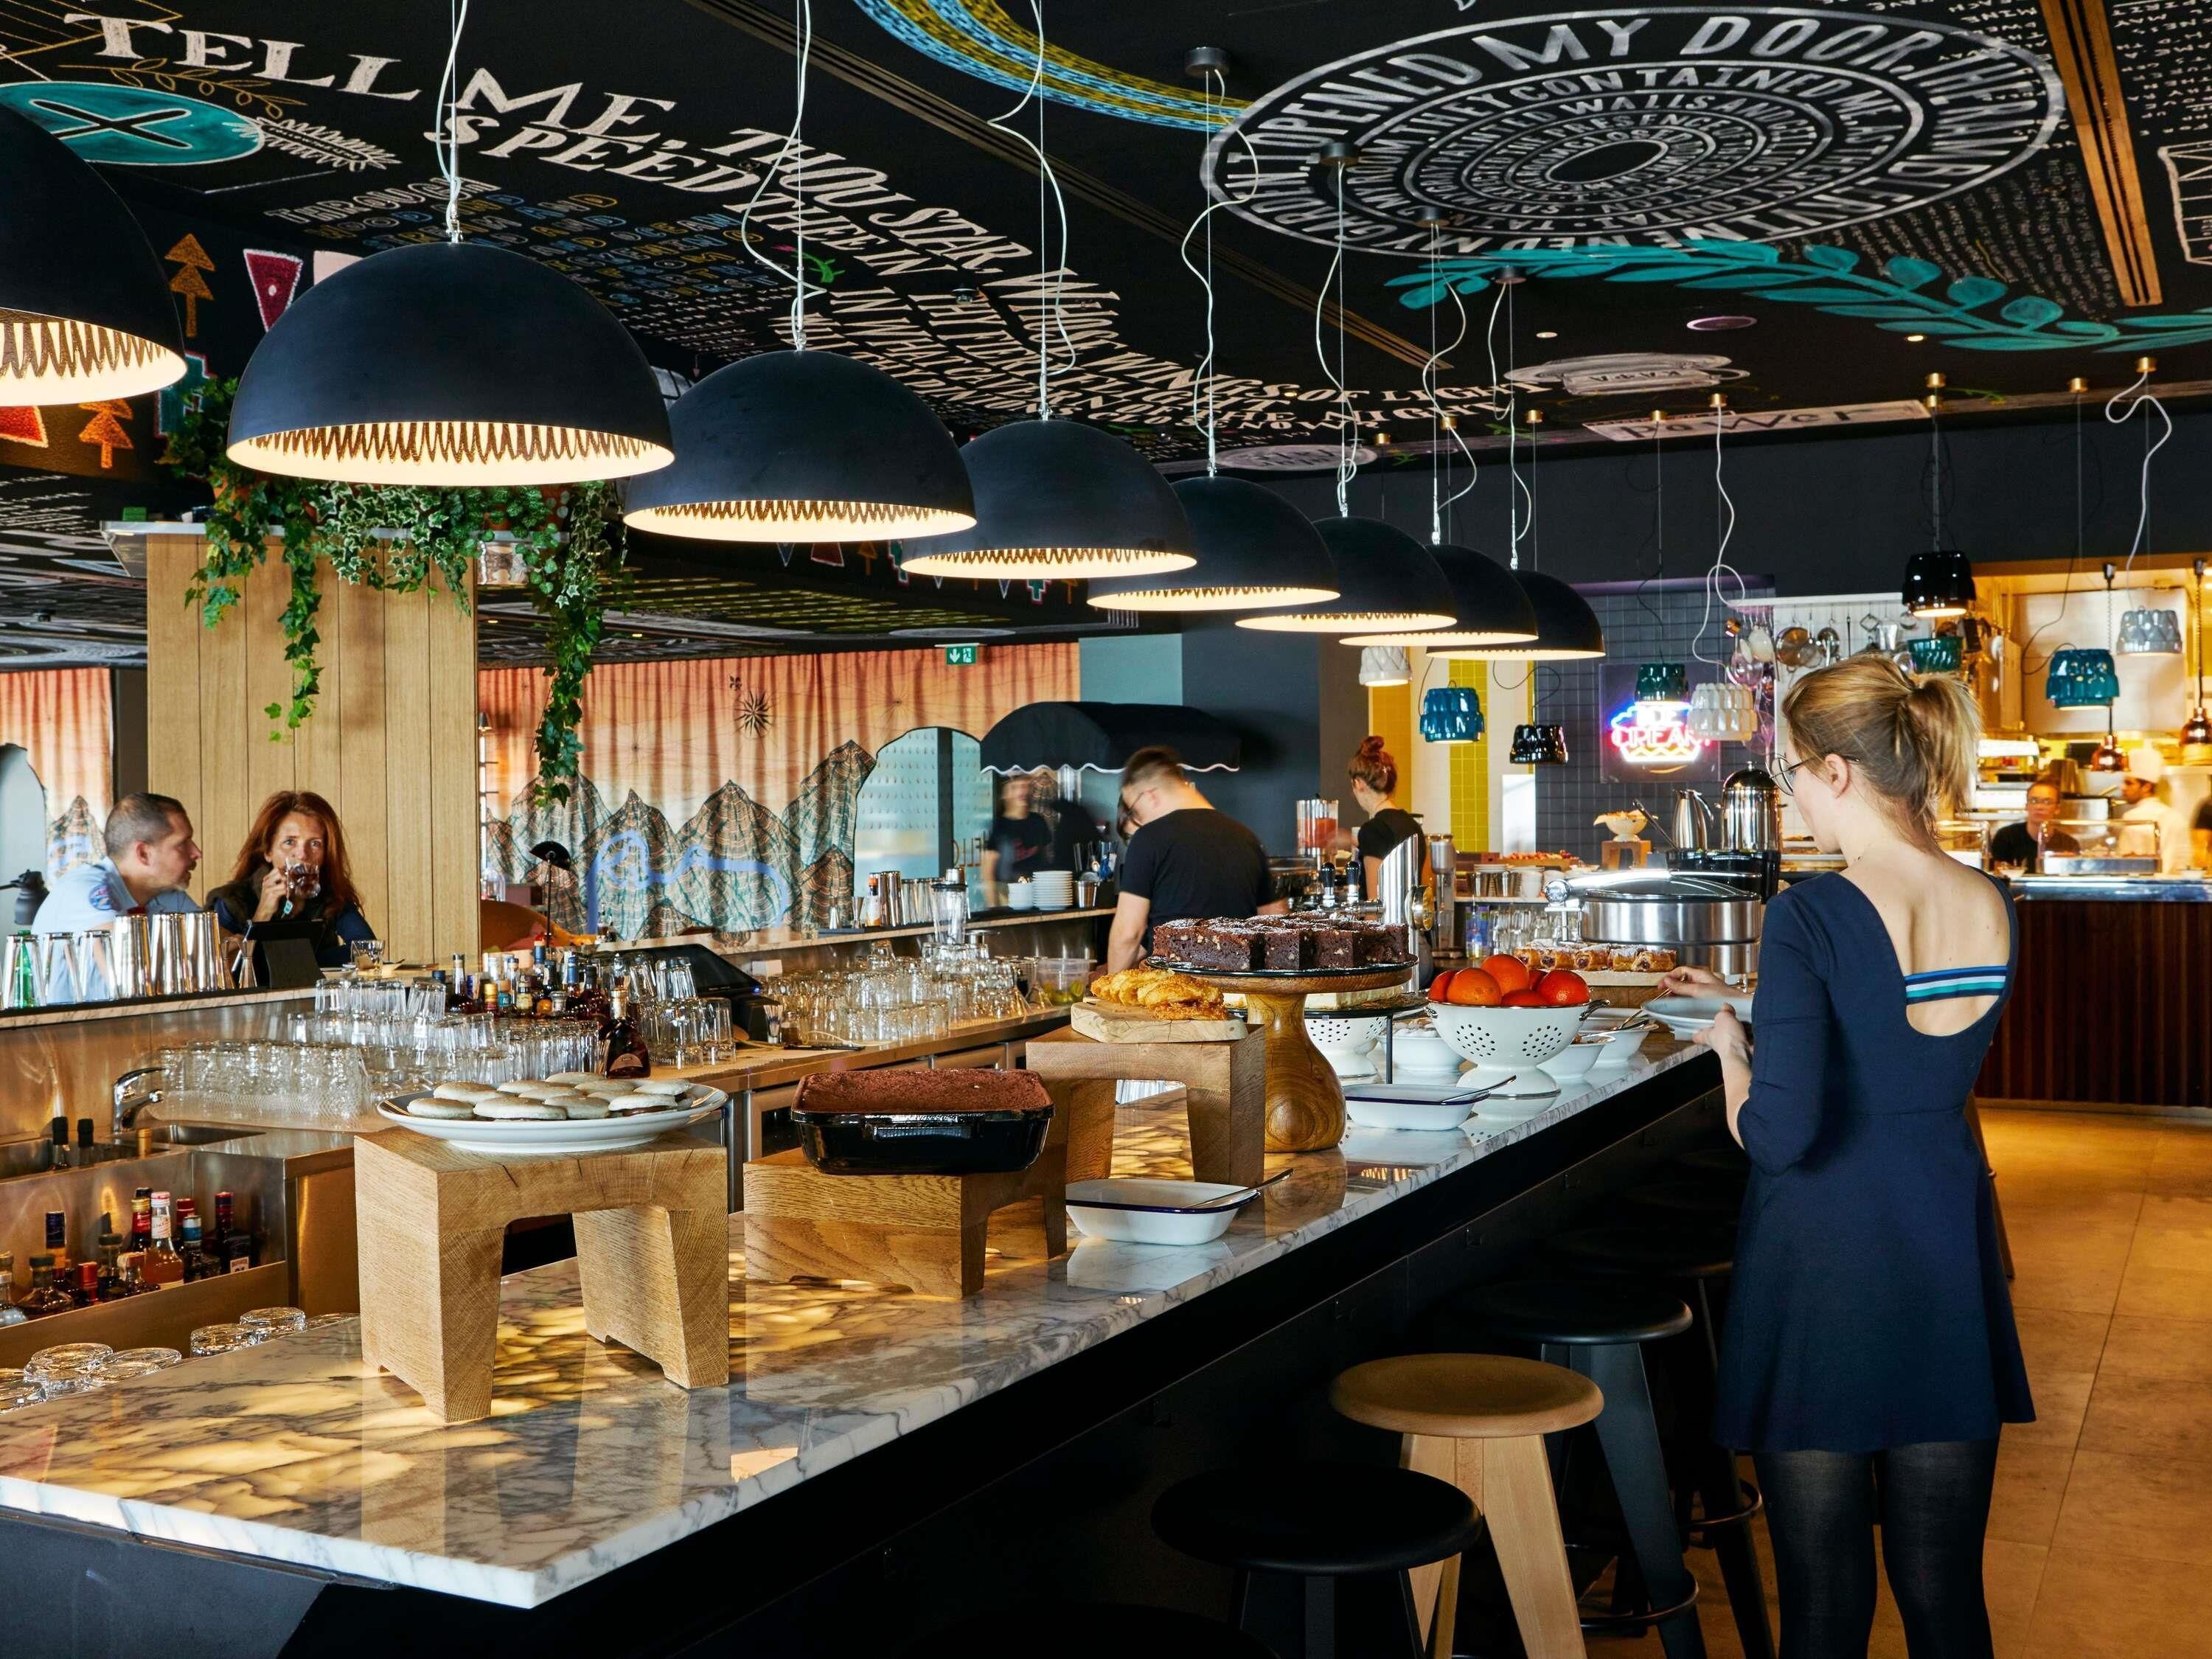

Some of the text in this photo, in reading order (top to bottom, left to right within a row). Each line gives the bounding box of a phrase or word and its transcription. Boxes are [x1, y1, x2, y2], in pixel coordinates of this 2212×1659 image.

[1959, 7, 2037, 23] MINE
[1471, 18, 1652, 71] MY
[1679, 15, 1944, 73] DOOR.
[1509, 67, 1852, 101] CONTAINED
[1897, 51, 2035, 106] THE
[1244, 53, 1483, 147] OPENED
[1559, 94, 1717, 115] WALLS
[1713, 98, 1795, 123] AND
[1389, 93, 1512, 135] THEY
[1543, 114, 1731, 138] PRESENCE
[1429, 111, 1557, 164] PAINTED
[1494, 136, 1554, 156] THE
[1712, 126, 1752, 139] OF
[1743, 119, 1818, 173] CEILING
[1845, 125, 1905, 144] AS
[1516, 148, 1578, 176] ROOM
[1564, 129, 1693, 149] CLOSED
[1711, 139, 1753, 159] THE
[1804, 145, 1890, 173] THE
[1420, 167, 1458, 193] GRAY
[1673, 175, 1761, 200] THEY
[1761, 171, 1833, 198] SKY
[63, 13, 420, 101] TELL
[445, 68, 686, 150] ME,
[700, 128, 915, 210] THOU
[981, 267, 1130, 359] WHOSE
[1080, 351, 1301, 400] WINGS
[1297, 389, 1370, 402] OF
[1382, 381, 1551, 402] LIGHT
[264, 177, 501, 224] THROUGH
[1355, 187, 1411, 209] MY
[1371, 232, 1493, 253] MY
[424, 115, 1292, 413] SPEED THEE IN THY FIERY FLIGHT
[829, 287, 1514, 422] IN WHAT CAVERN OF THE NIGHT
[1088, 411, 1229, 428] CLOSE
[1637, 705, 1684, 726] ICE
